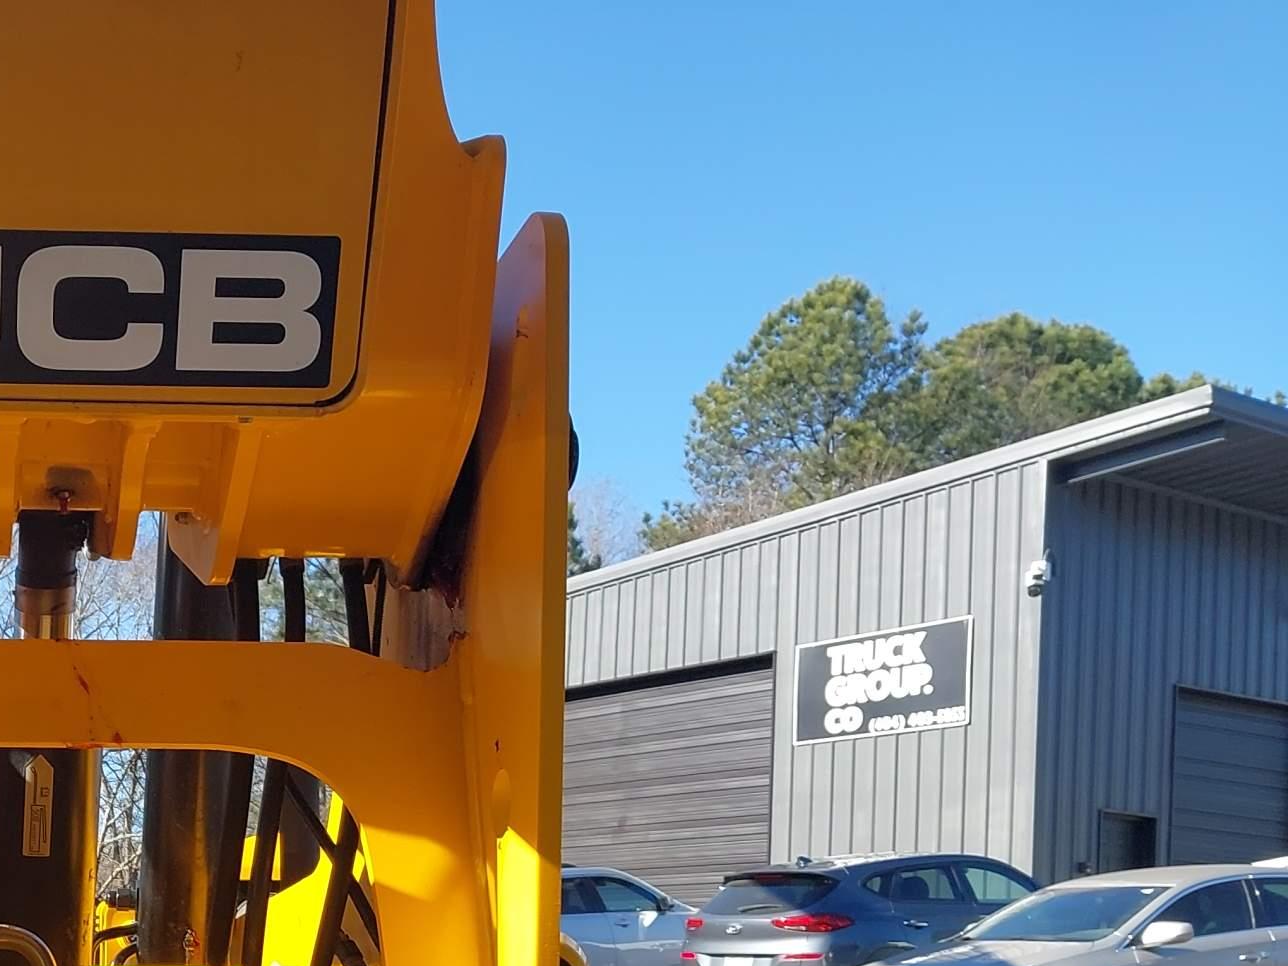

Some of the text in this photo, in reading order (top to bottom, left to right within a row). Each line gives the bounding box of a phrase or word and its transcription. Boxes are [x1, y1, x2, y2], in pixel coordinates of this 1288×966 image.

[826, 630, 928, 676] TRUCK
[824, 662, 935, 707] GROUP.
[823, 705, 864, 735] CO
